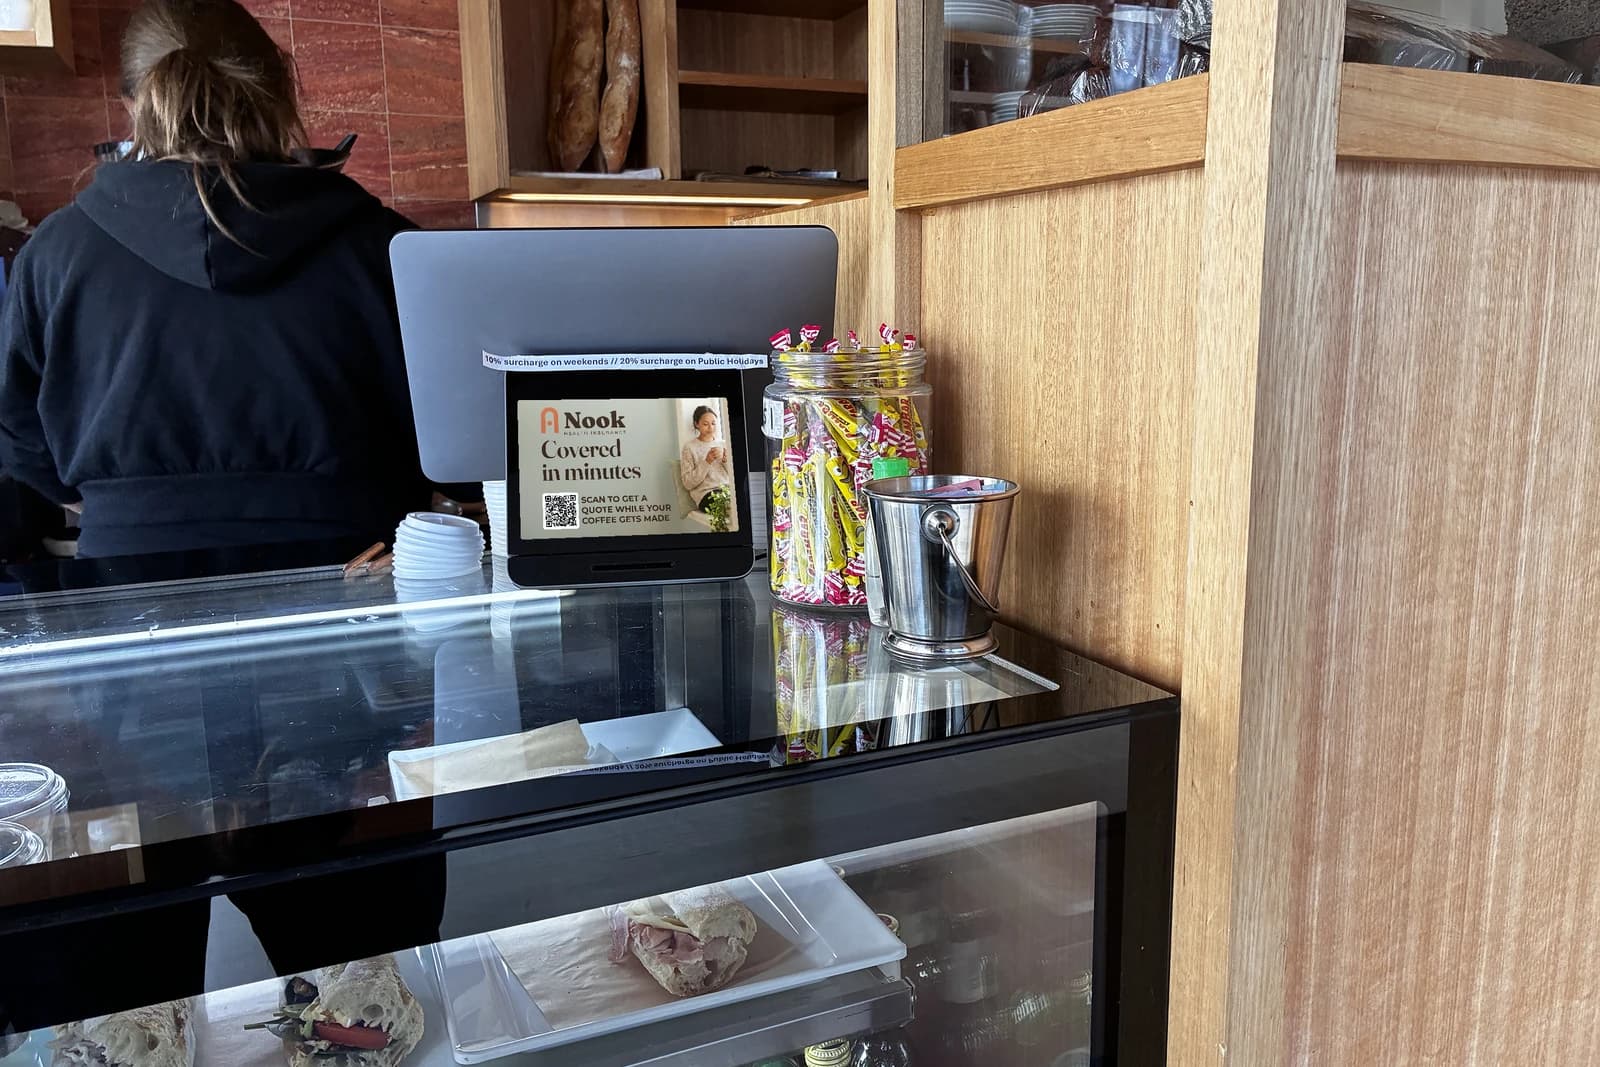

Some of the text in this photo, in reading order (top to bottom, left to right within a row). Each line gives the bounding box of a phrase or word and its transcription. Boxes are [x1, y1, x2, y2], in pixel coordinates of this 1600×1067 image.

[485, 355, 502, 365] 10%
[503, 359, 549, 368] surcharge
[563, 357, 609, 366] weekends
[619, 357, 639, 365] 20%
[640, 357, 684, 366] surcharge
[698, 357, 725, 365] Public
[727, 357, 764, 366] Holidays
[564, 410, 626, 429] Nook
[541, 438, 621, 459] Covered
[542, 462, 641, 481] in minutes
[581, 494, 648, 504] SCAN TO GET A
[581, 503, 672, 515] QUOTE WHILE YOUR
[582, 514, 670, 525] COFFEE GETS MADE
